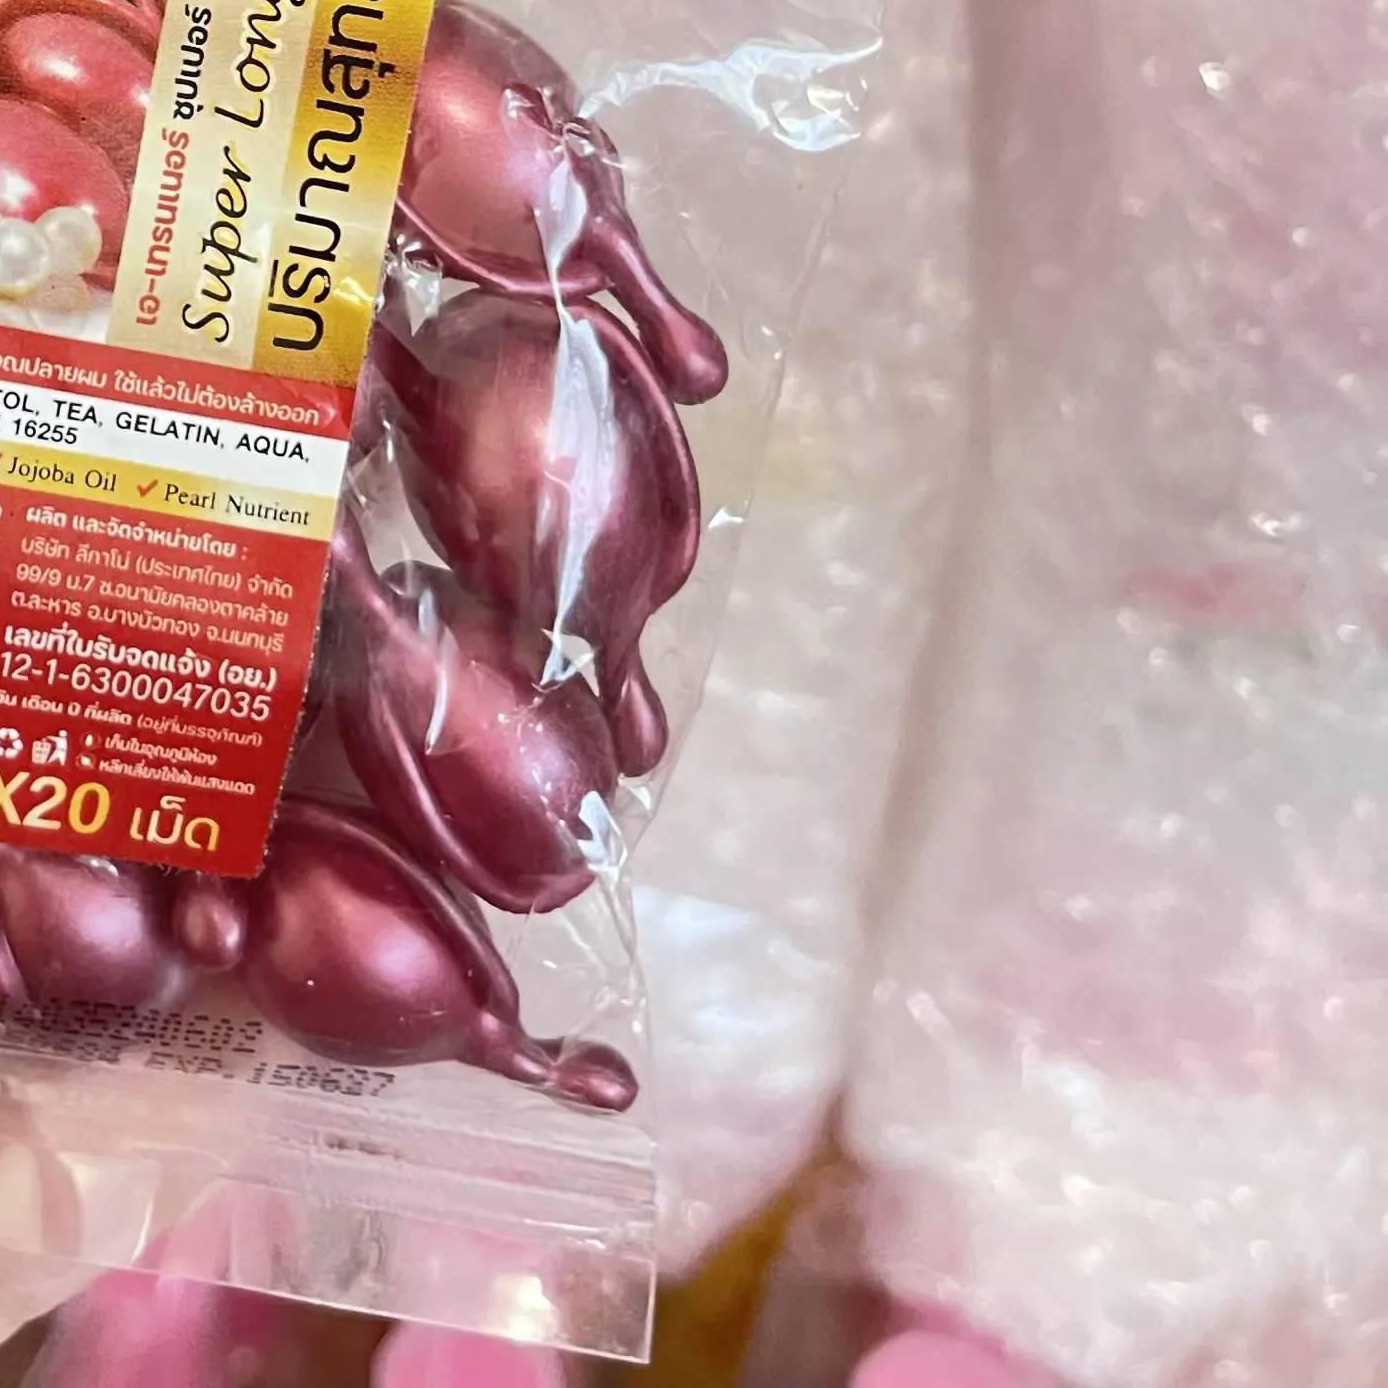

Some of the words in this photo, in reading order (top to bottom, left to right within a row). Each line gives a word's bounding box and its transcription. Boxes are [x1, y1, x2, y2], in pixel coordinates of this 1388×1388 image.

[137, 129, 189, 326] เอ-เทรนเนอร์
[173, 8, 211, 120] ซุปเปอร์
[182, 145, 259, 345] Super
[14, 419, 77, 444] 16255
[54, 400, 105, 428] TEA,
[116, 412, 226, 450] GELATIN,
[236, 434, 311, 464] AQUA,
[8, 457, 74, 484] Jojoba
[85, 470, 116, 492] Oil
[27, 506, 67, 527] ผลิต
[165, 484, 215, 509] Pearl
[227, 495, 308, 525] Nutrient
[17, 564, 61, 586] 99/9
[1, 652, 271, 721] 12-1-6300047035
[130, 796, 219, 850] เม็ด
